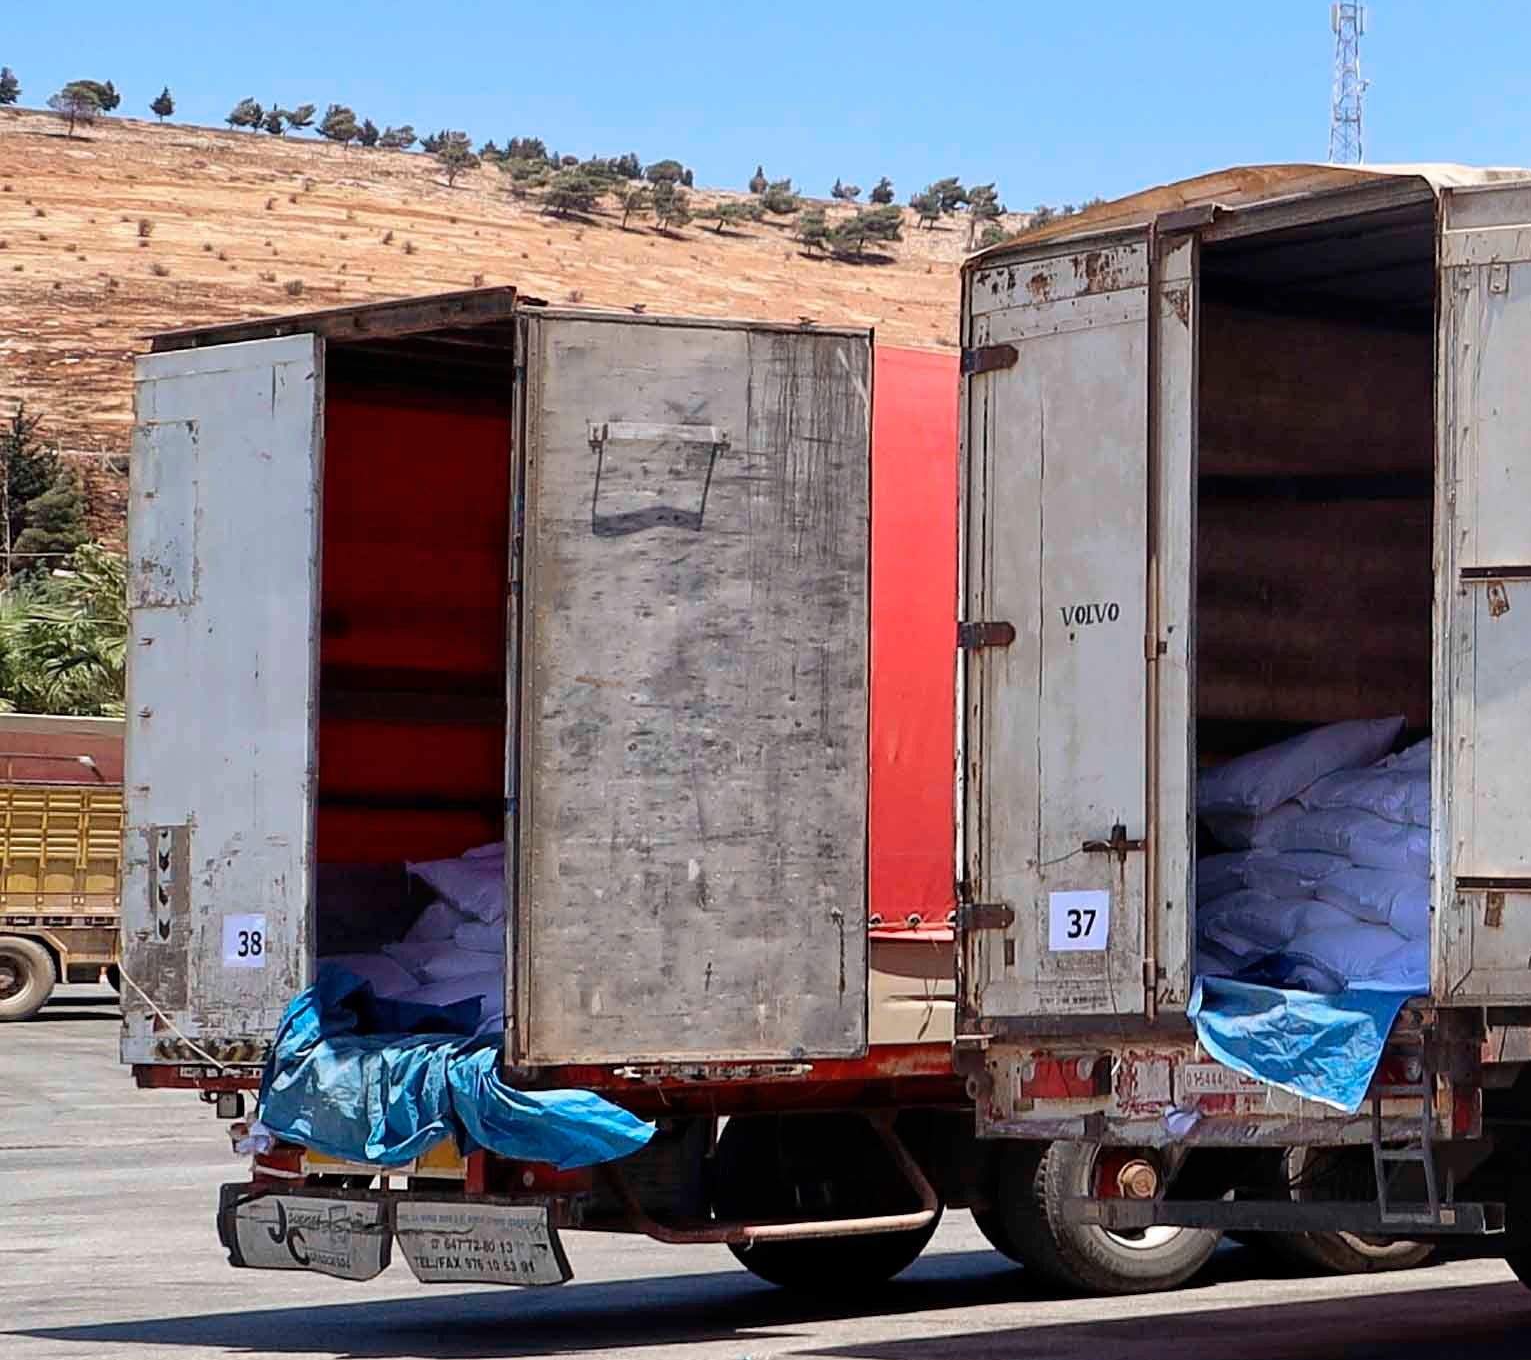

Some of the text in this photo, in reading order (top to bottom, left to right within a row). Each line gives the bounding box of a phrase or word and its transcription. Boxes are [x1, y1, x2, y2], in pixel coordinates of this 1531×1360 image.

[1060, 603, 1120, 627] VOLVO
[1066, 908, 1098, 939] 37
[237, 930, 263, 957] 38
